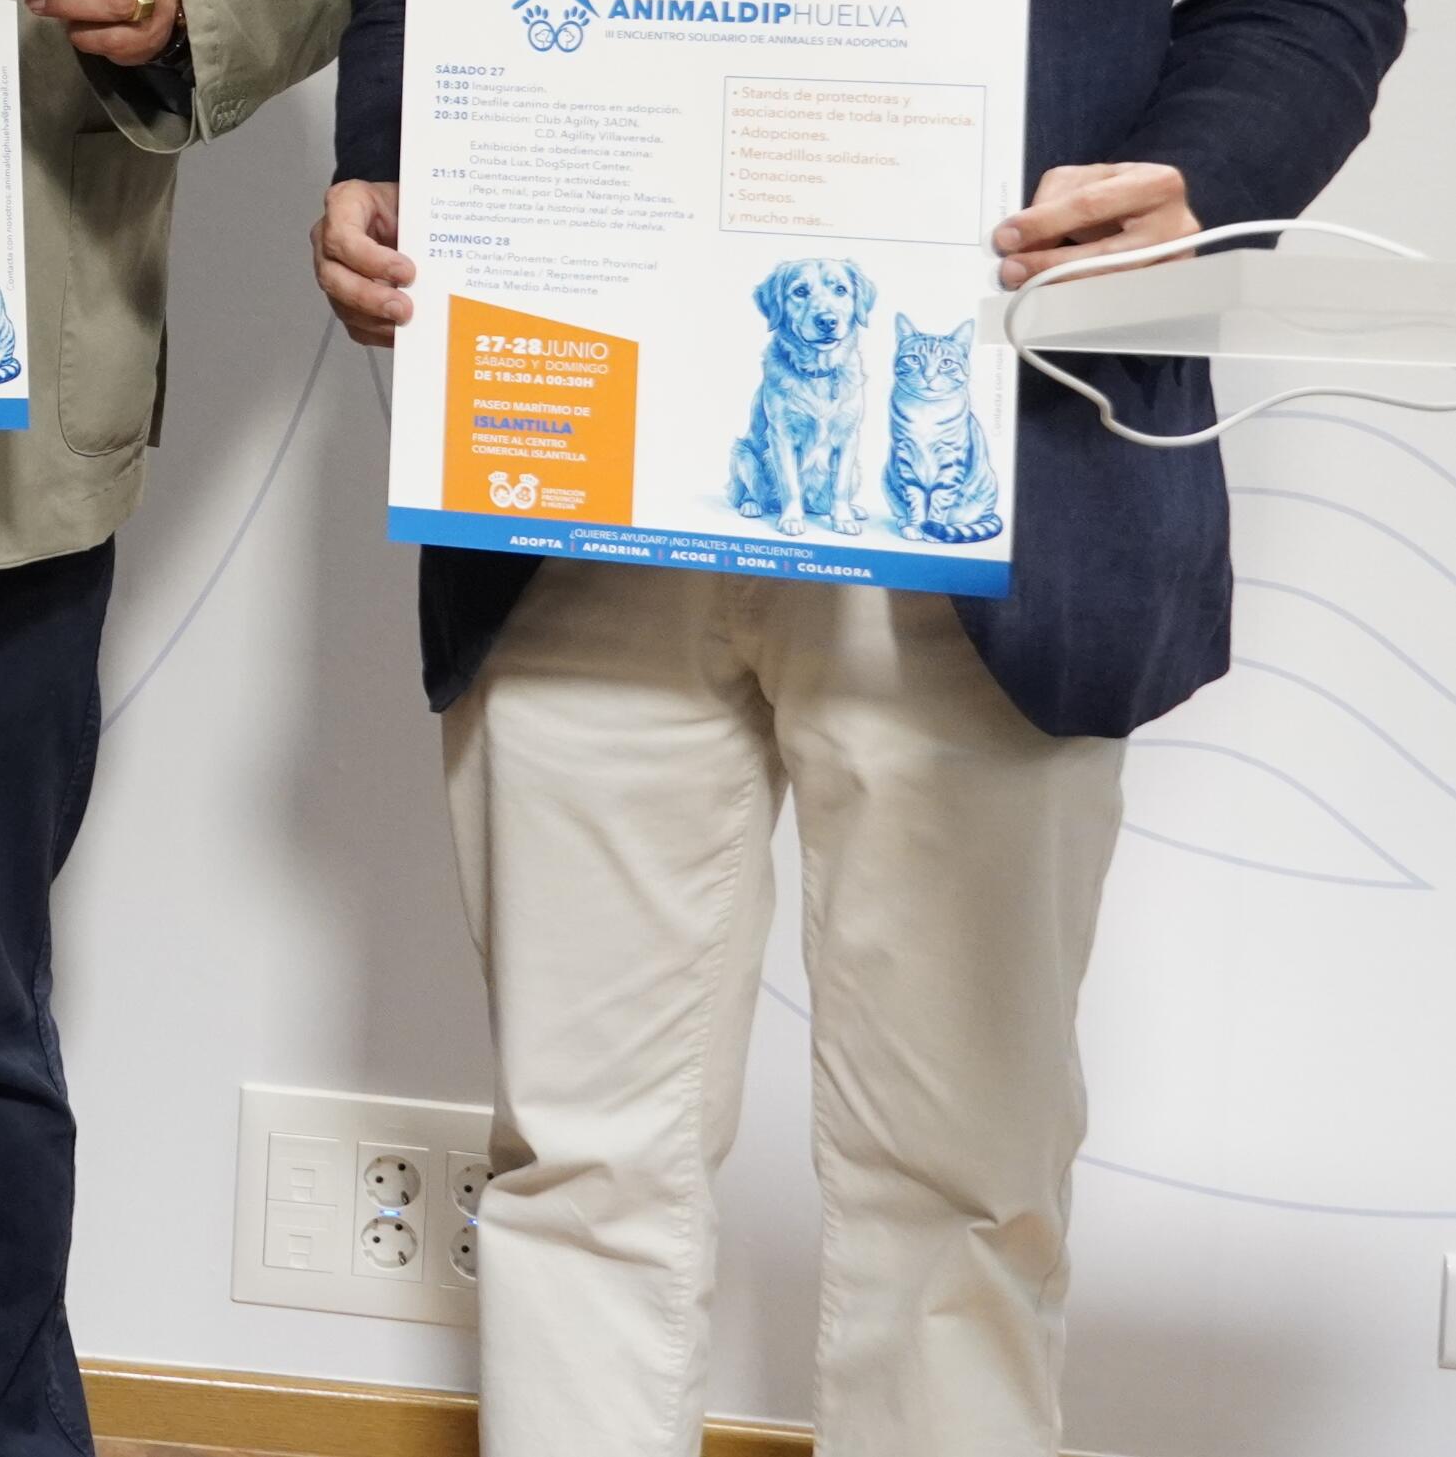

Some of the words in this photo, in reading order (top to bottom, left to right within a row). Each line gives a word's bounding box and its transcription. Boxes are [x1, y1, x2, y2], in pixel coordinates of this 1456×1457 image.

[489, 66, 505, 76] 27
[429, 232, 492, 245] DOMINGO
[495, 236, 510, 246] 28
[473, 398, 513, 411] PASEO
[572, 405, 591, 417] DE
[473, 415, 575, 435] ISLANTILLA
[509, 535, 563, 549] ADOPTA
[582, 542, 650, 556] APADRINA
[670, 550, 716, 563] ACOGE
[736, 556, 777, 569] DONA
[796, 562, 872, 578] COLABORA
